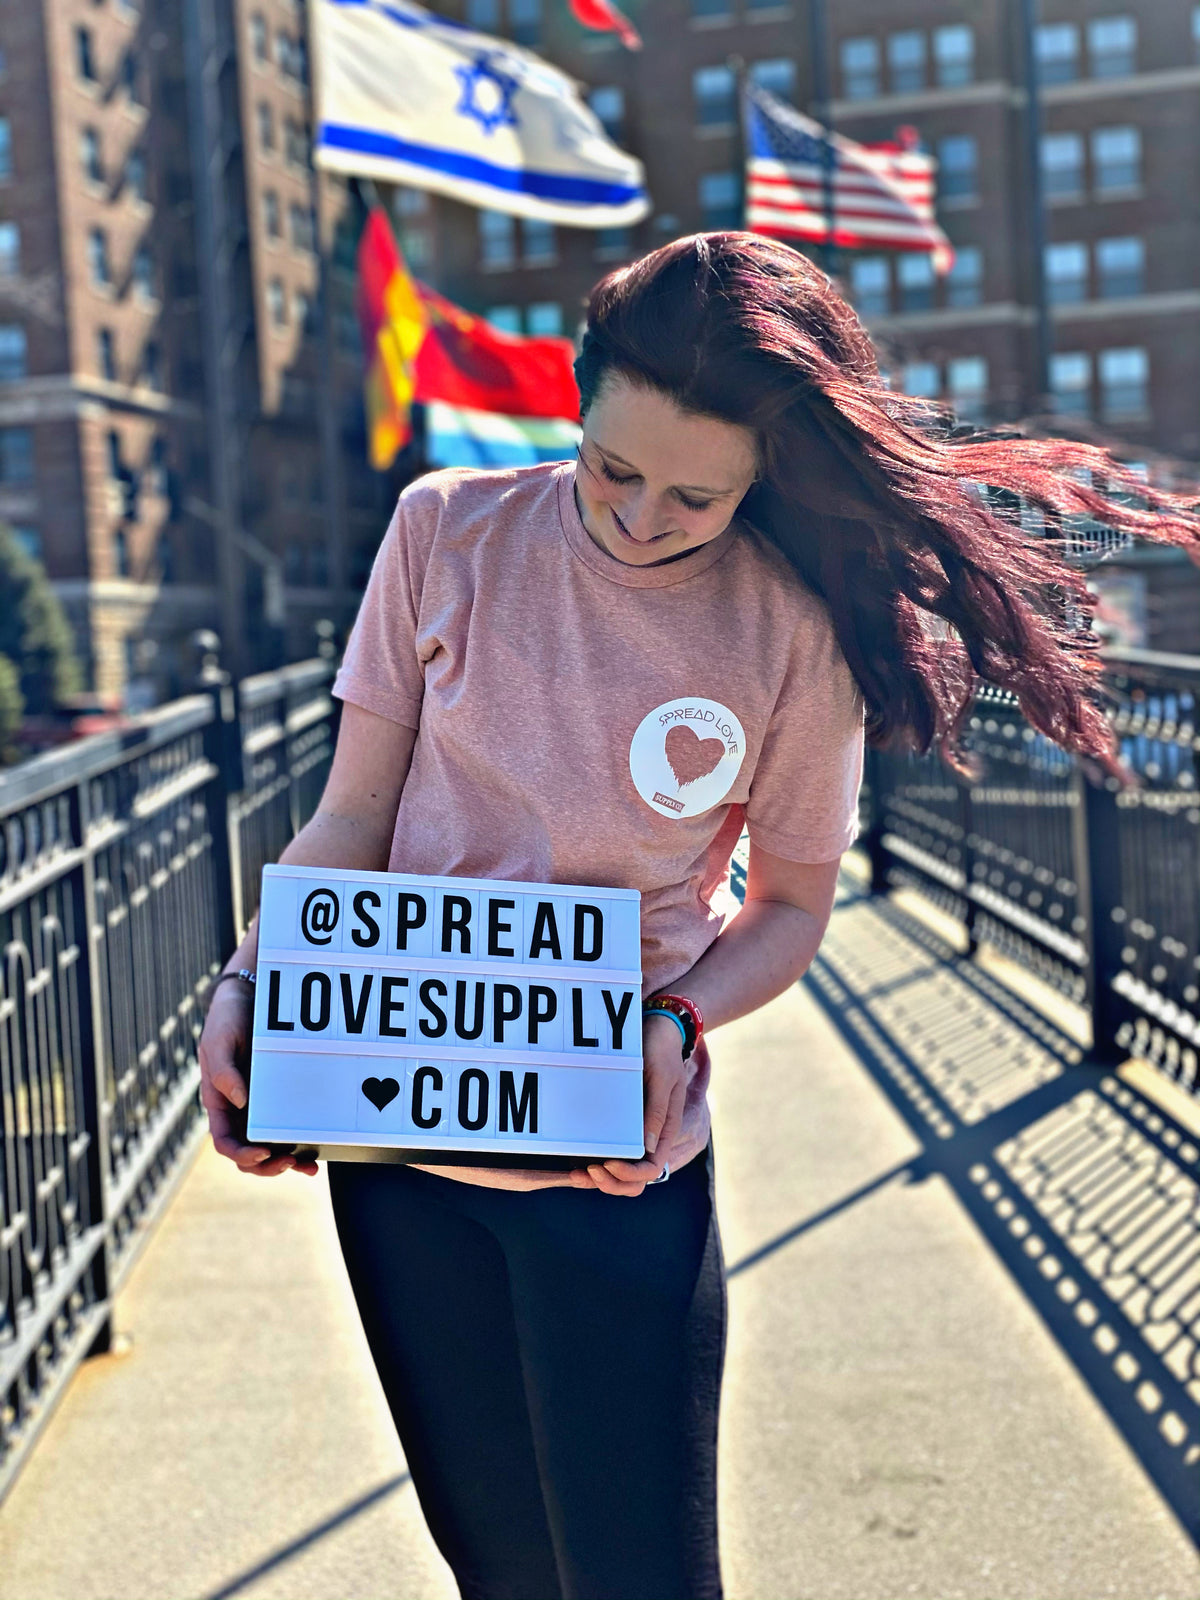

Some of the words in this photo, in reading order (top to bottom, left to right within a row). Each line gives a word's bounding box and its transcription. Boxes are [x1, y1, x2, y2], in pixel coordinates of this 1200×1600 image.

[658, 707, 715, 727] SPREAD
[714, 717, 739, 757] LOVE
[654, 793, 676, 808] SUPPLY
[301, 888, 604, 962] @SPREAD
[267, 970, 634, 1050] LOVESUPPLY
